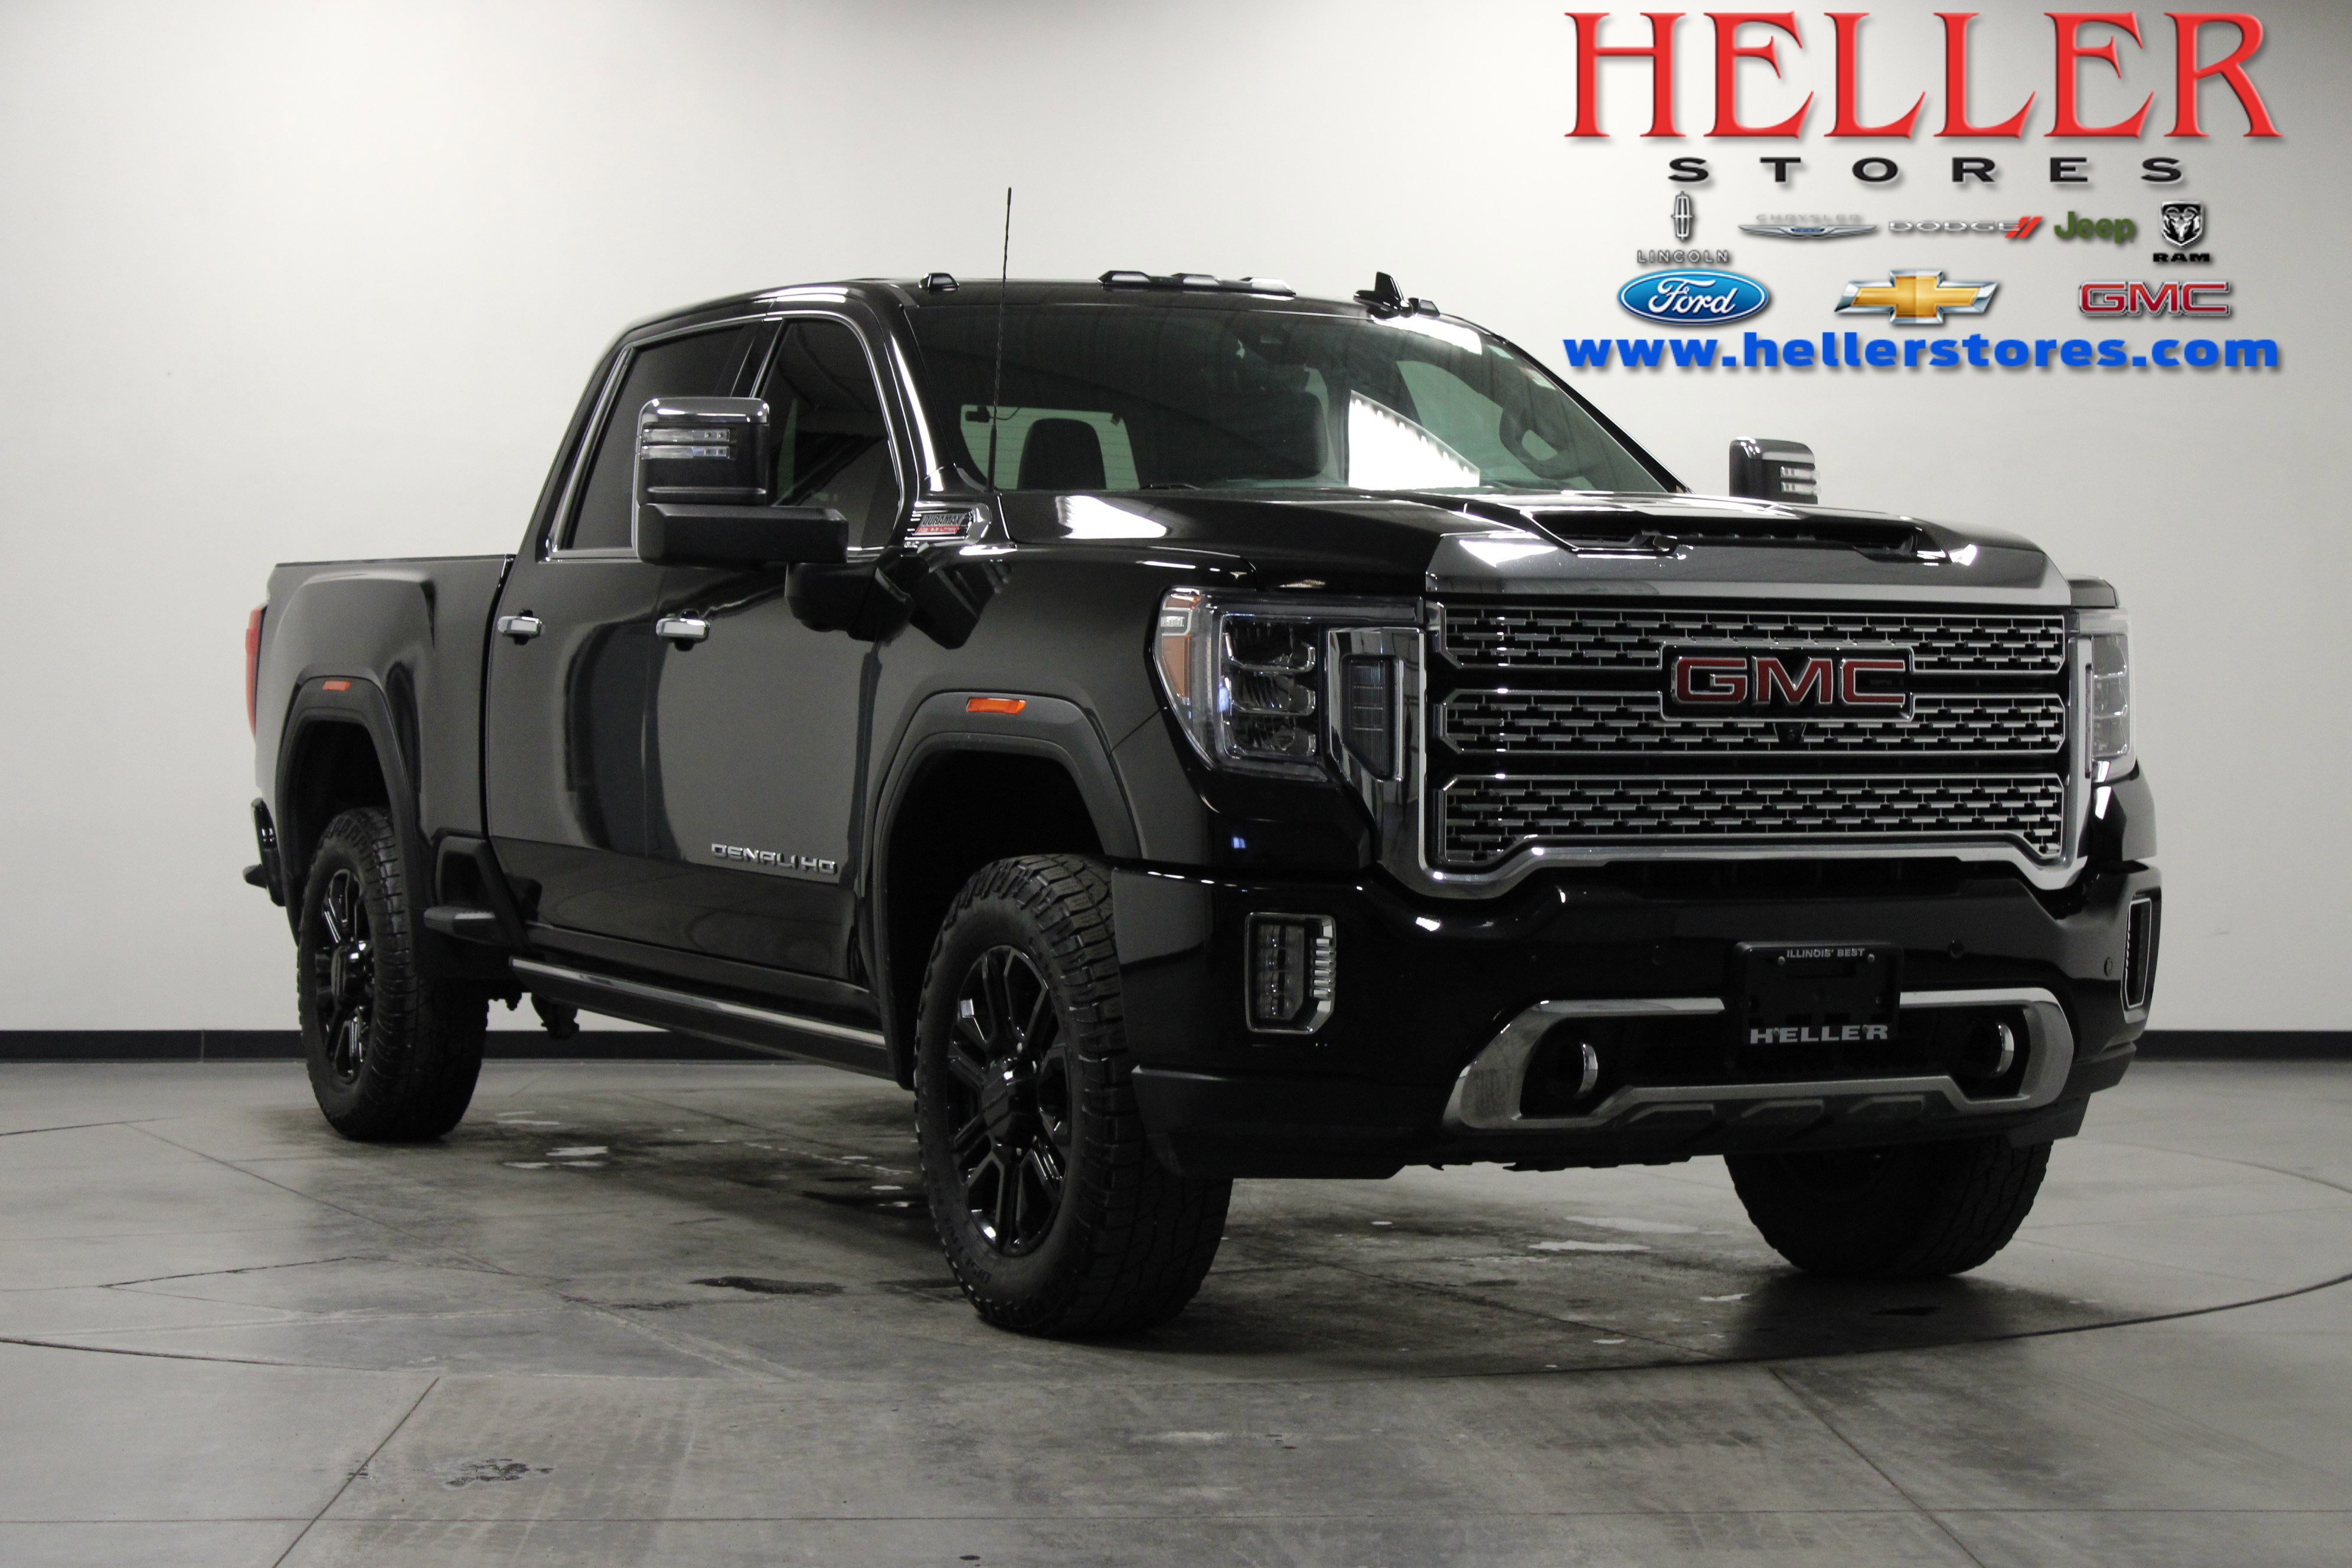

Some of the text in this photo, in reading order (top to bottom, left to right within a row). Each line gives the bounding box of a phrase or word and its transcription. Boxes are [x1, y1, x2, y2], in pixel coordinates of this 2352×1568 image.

[923, 515, 961, 525] DURAMAX
[1671, 656, 1906, 705] GMC
[711, 843, 837, 874] DENALI HD
[1786, 948, 1865, 958] ILLINOIS' BEST
[1750, 1024, 1888, 1044] HELLER
